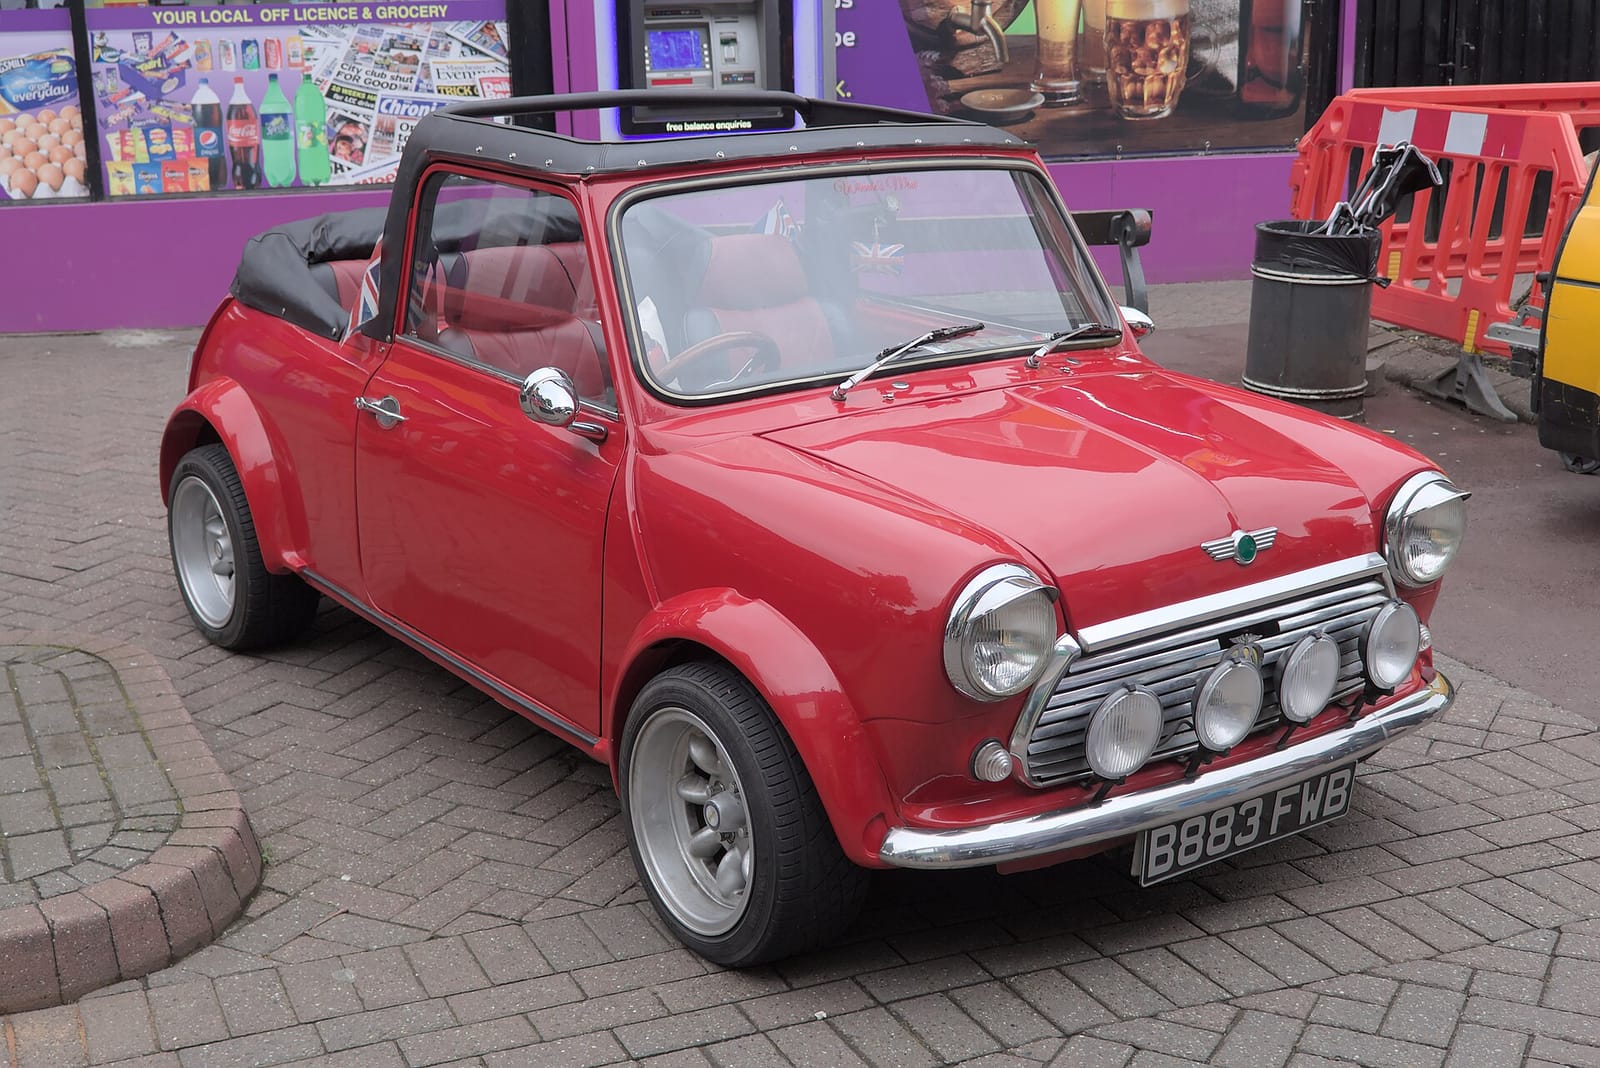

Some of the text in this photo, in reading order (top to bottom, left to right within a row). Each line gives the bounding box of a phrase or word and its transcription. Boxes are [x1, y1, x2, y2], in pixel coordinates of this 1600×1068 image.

[152, 5, 448, 24] YOUR LOCAL OFF LICENCE & GROCERY
[336, 70, 398, 91] FOR GOOD
[340, 62, 414, 84] City club shut
[438, 86, 471, 96] TRICK
[666, 119, 752, 131] free balance enquiries
[1147, 768, 1351, 878] B883 FWB
